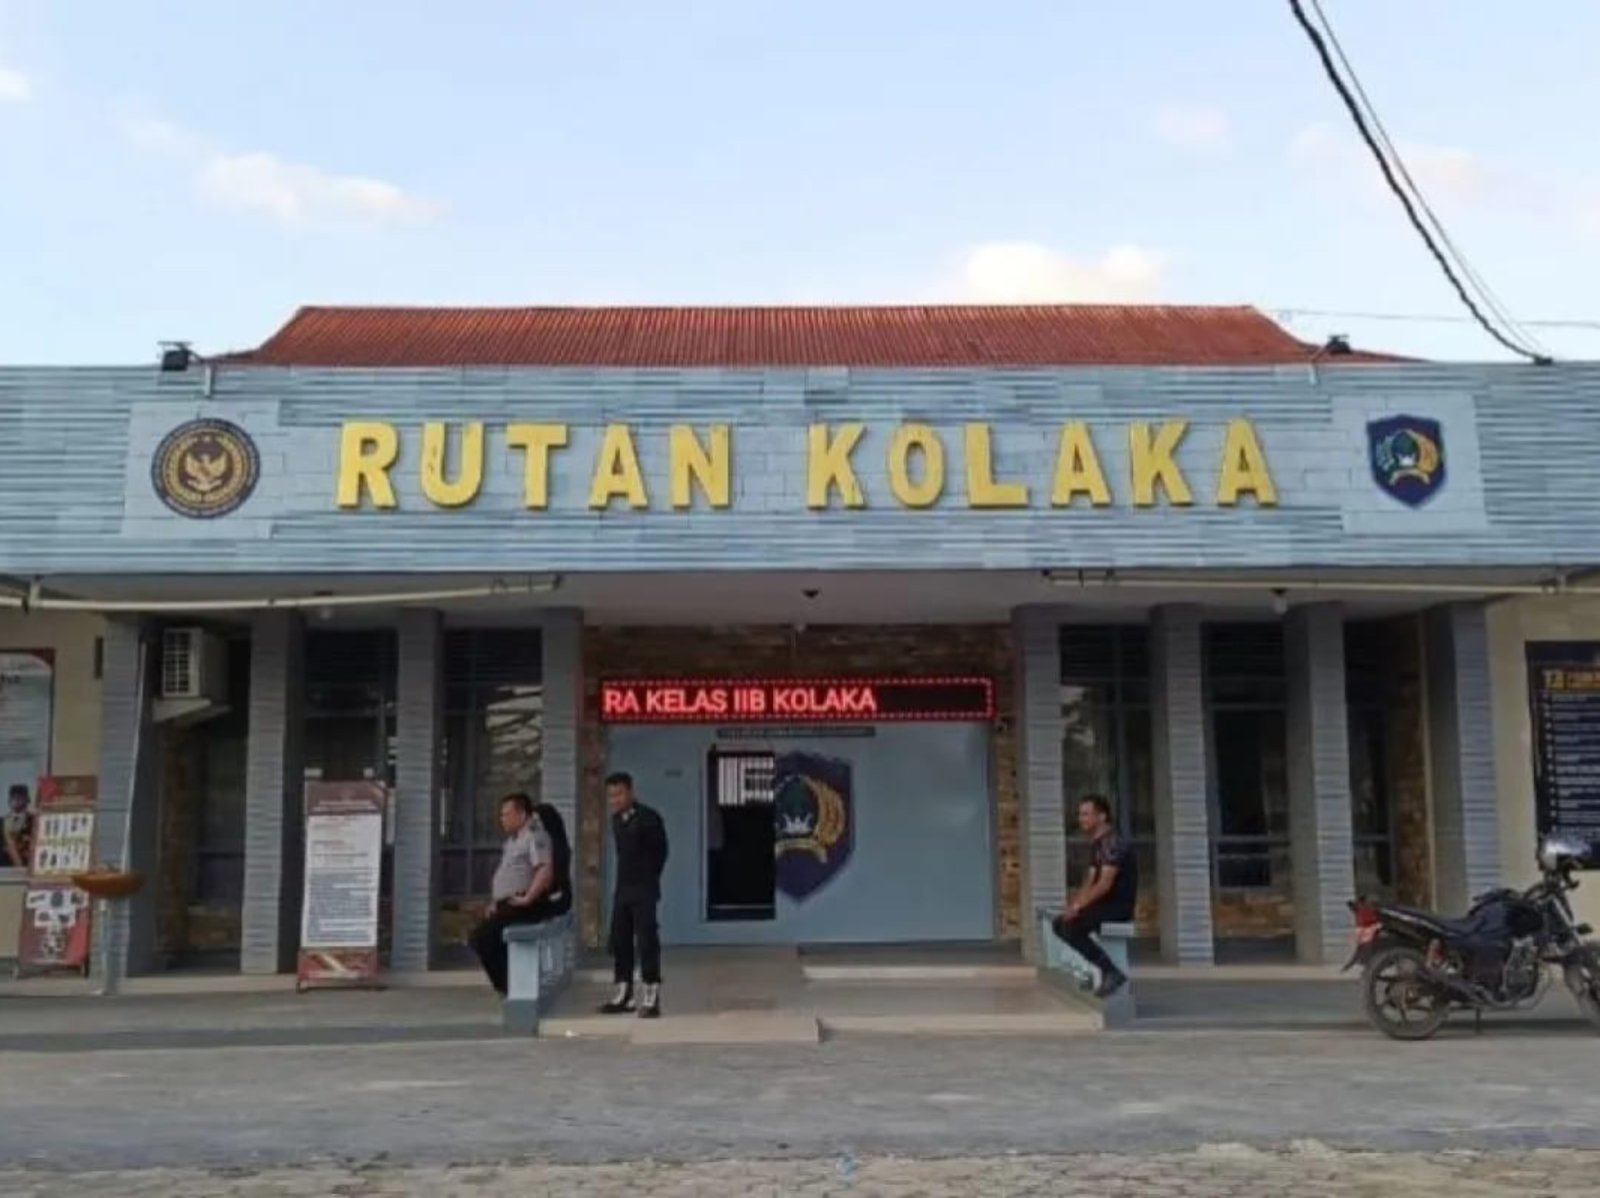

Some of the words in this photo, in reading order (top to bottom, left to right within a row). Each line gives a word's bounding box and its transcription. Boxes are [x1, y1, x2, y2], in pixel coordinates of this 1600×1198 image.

[335, 421, 731, 509] RUTAN
[806, 418, 1278, 509] KOLAKA
[603, 688, 639, 713] RA
[646, 688, 727, 713] KELAS
[734, 688, 766, 712] IIB
[773, 687, 877, 712] KOLAKA
